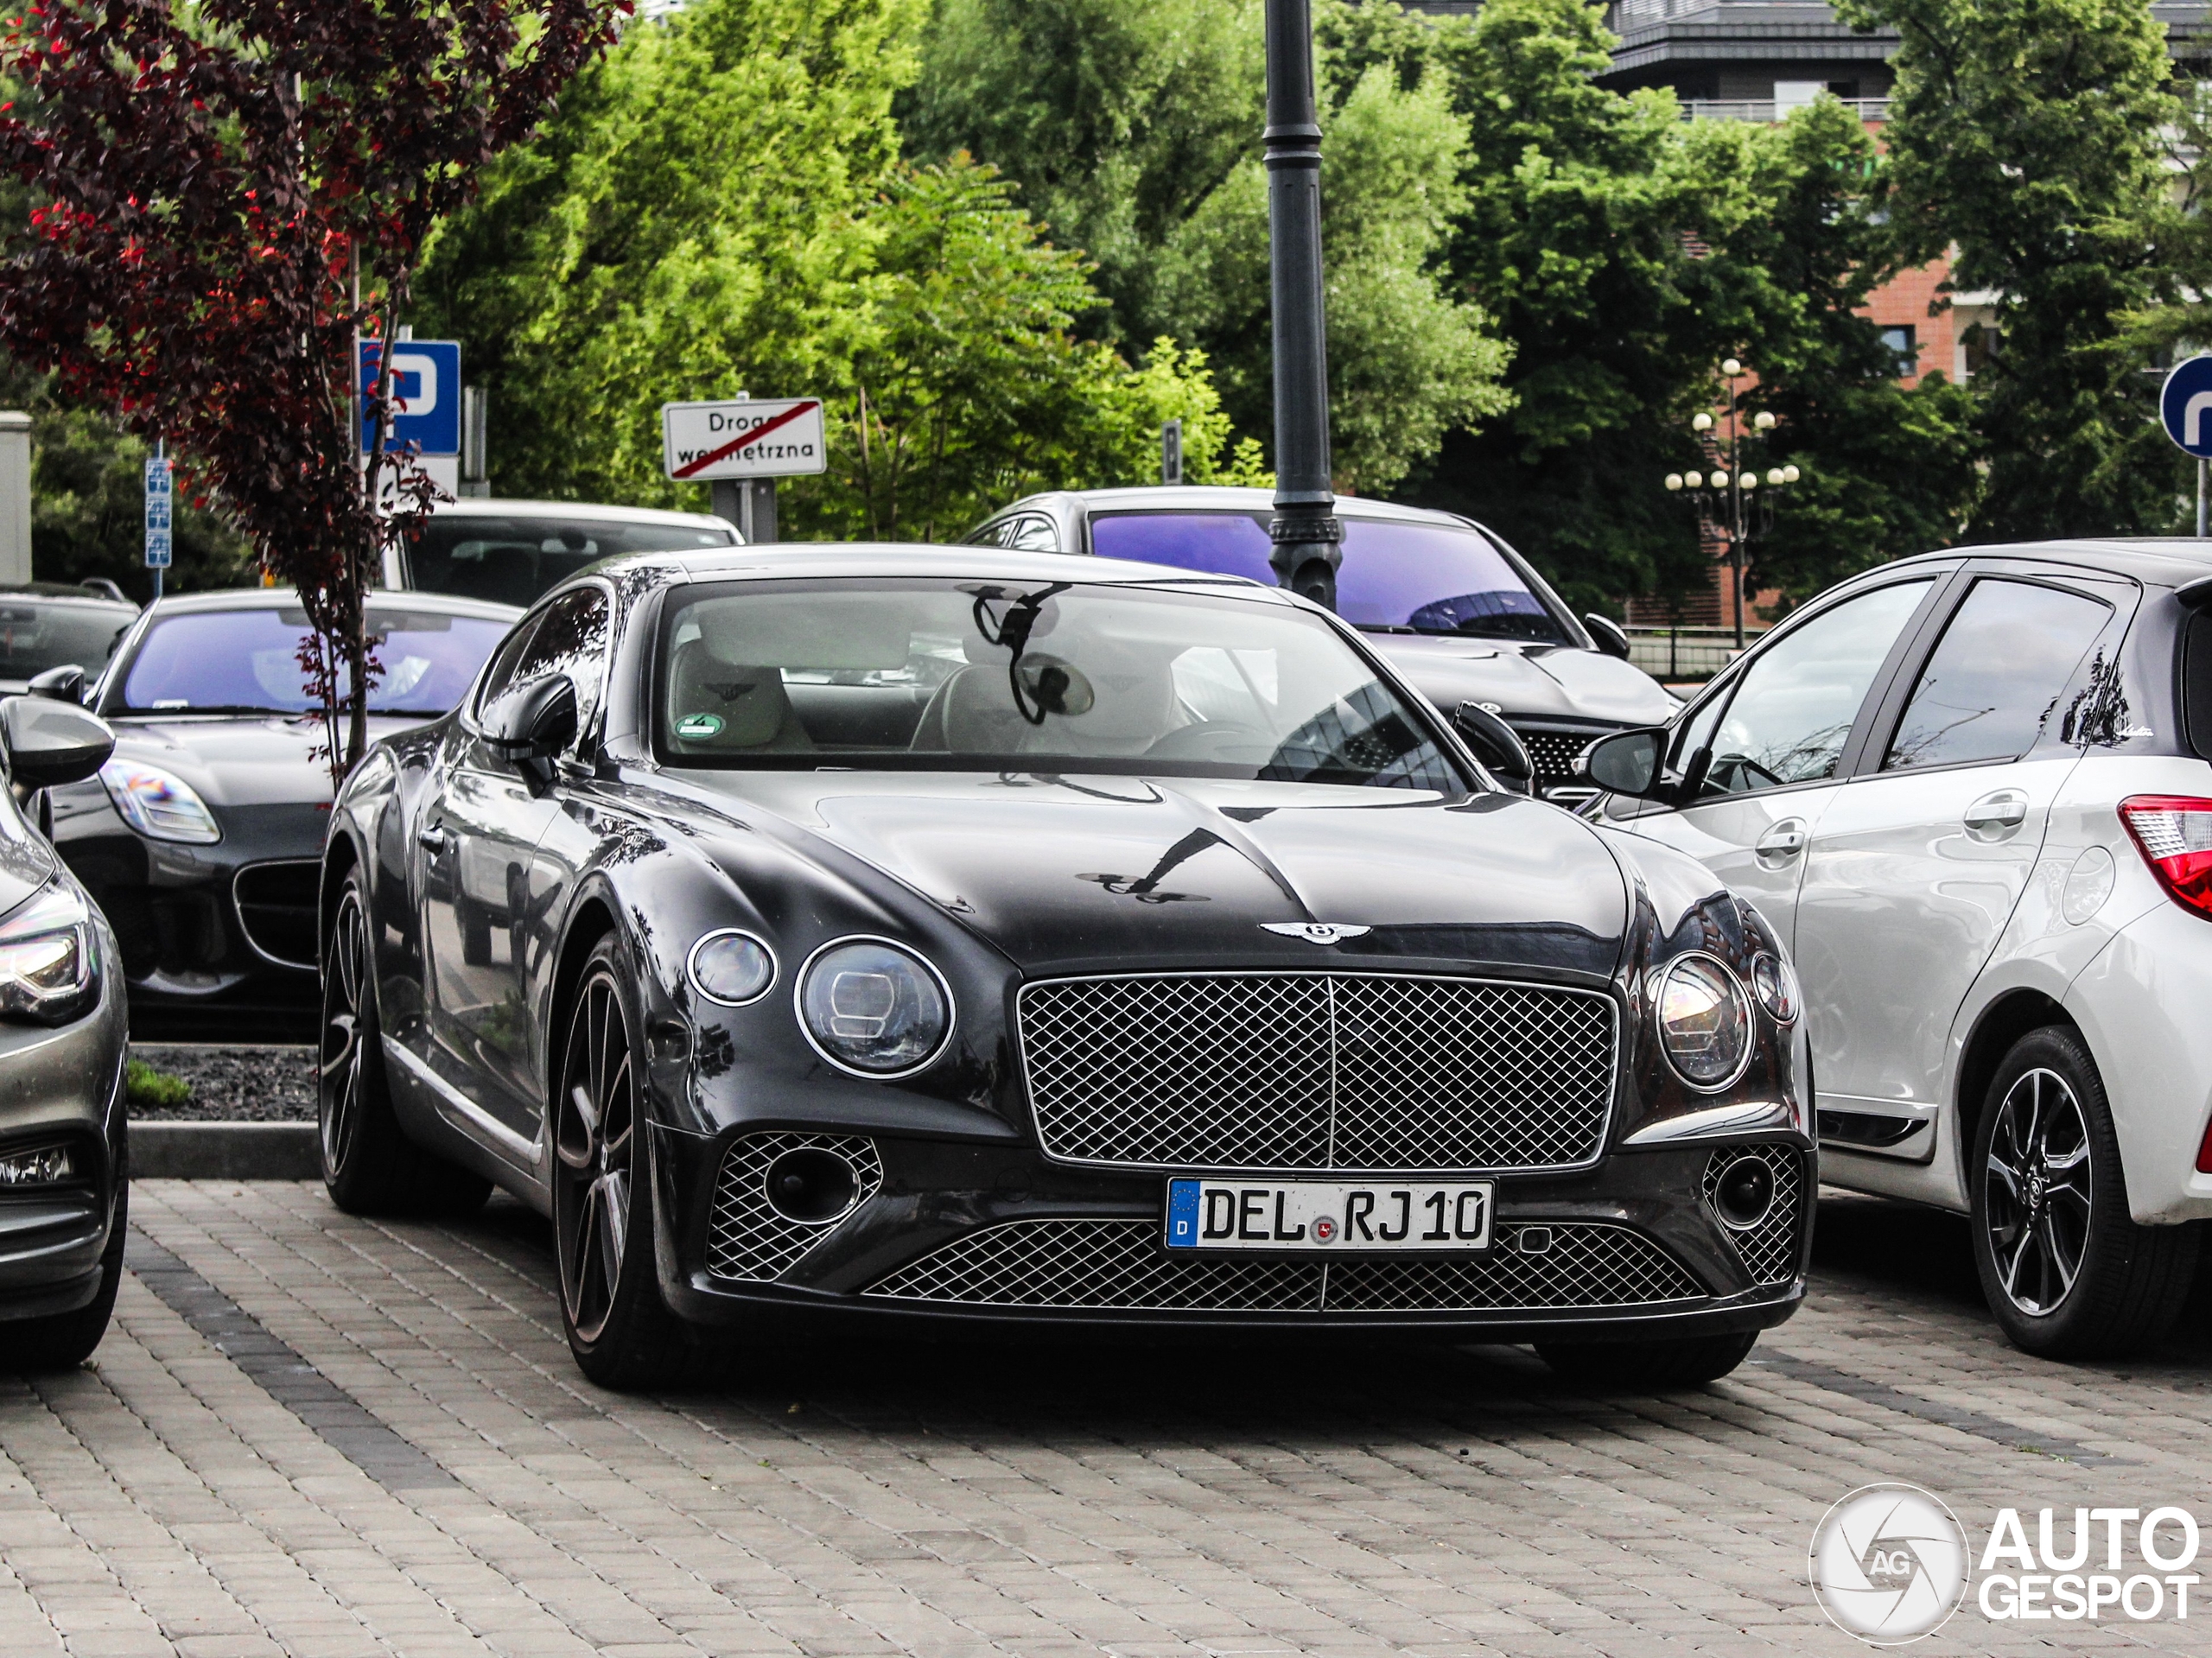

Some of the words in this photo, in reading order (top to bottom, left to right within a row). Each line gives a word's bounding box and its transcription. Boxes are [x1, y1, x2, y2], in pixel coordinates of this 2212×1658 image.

[378, 354, 437, 439] P
[709, 413, 779, 432] Drog
[1176, 1221, 1189, 1236] D
[1202, 1188, 1306, 1241] DEL
